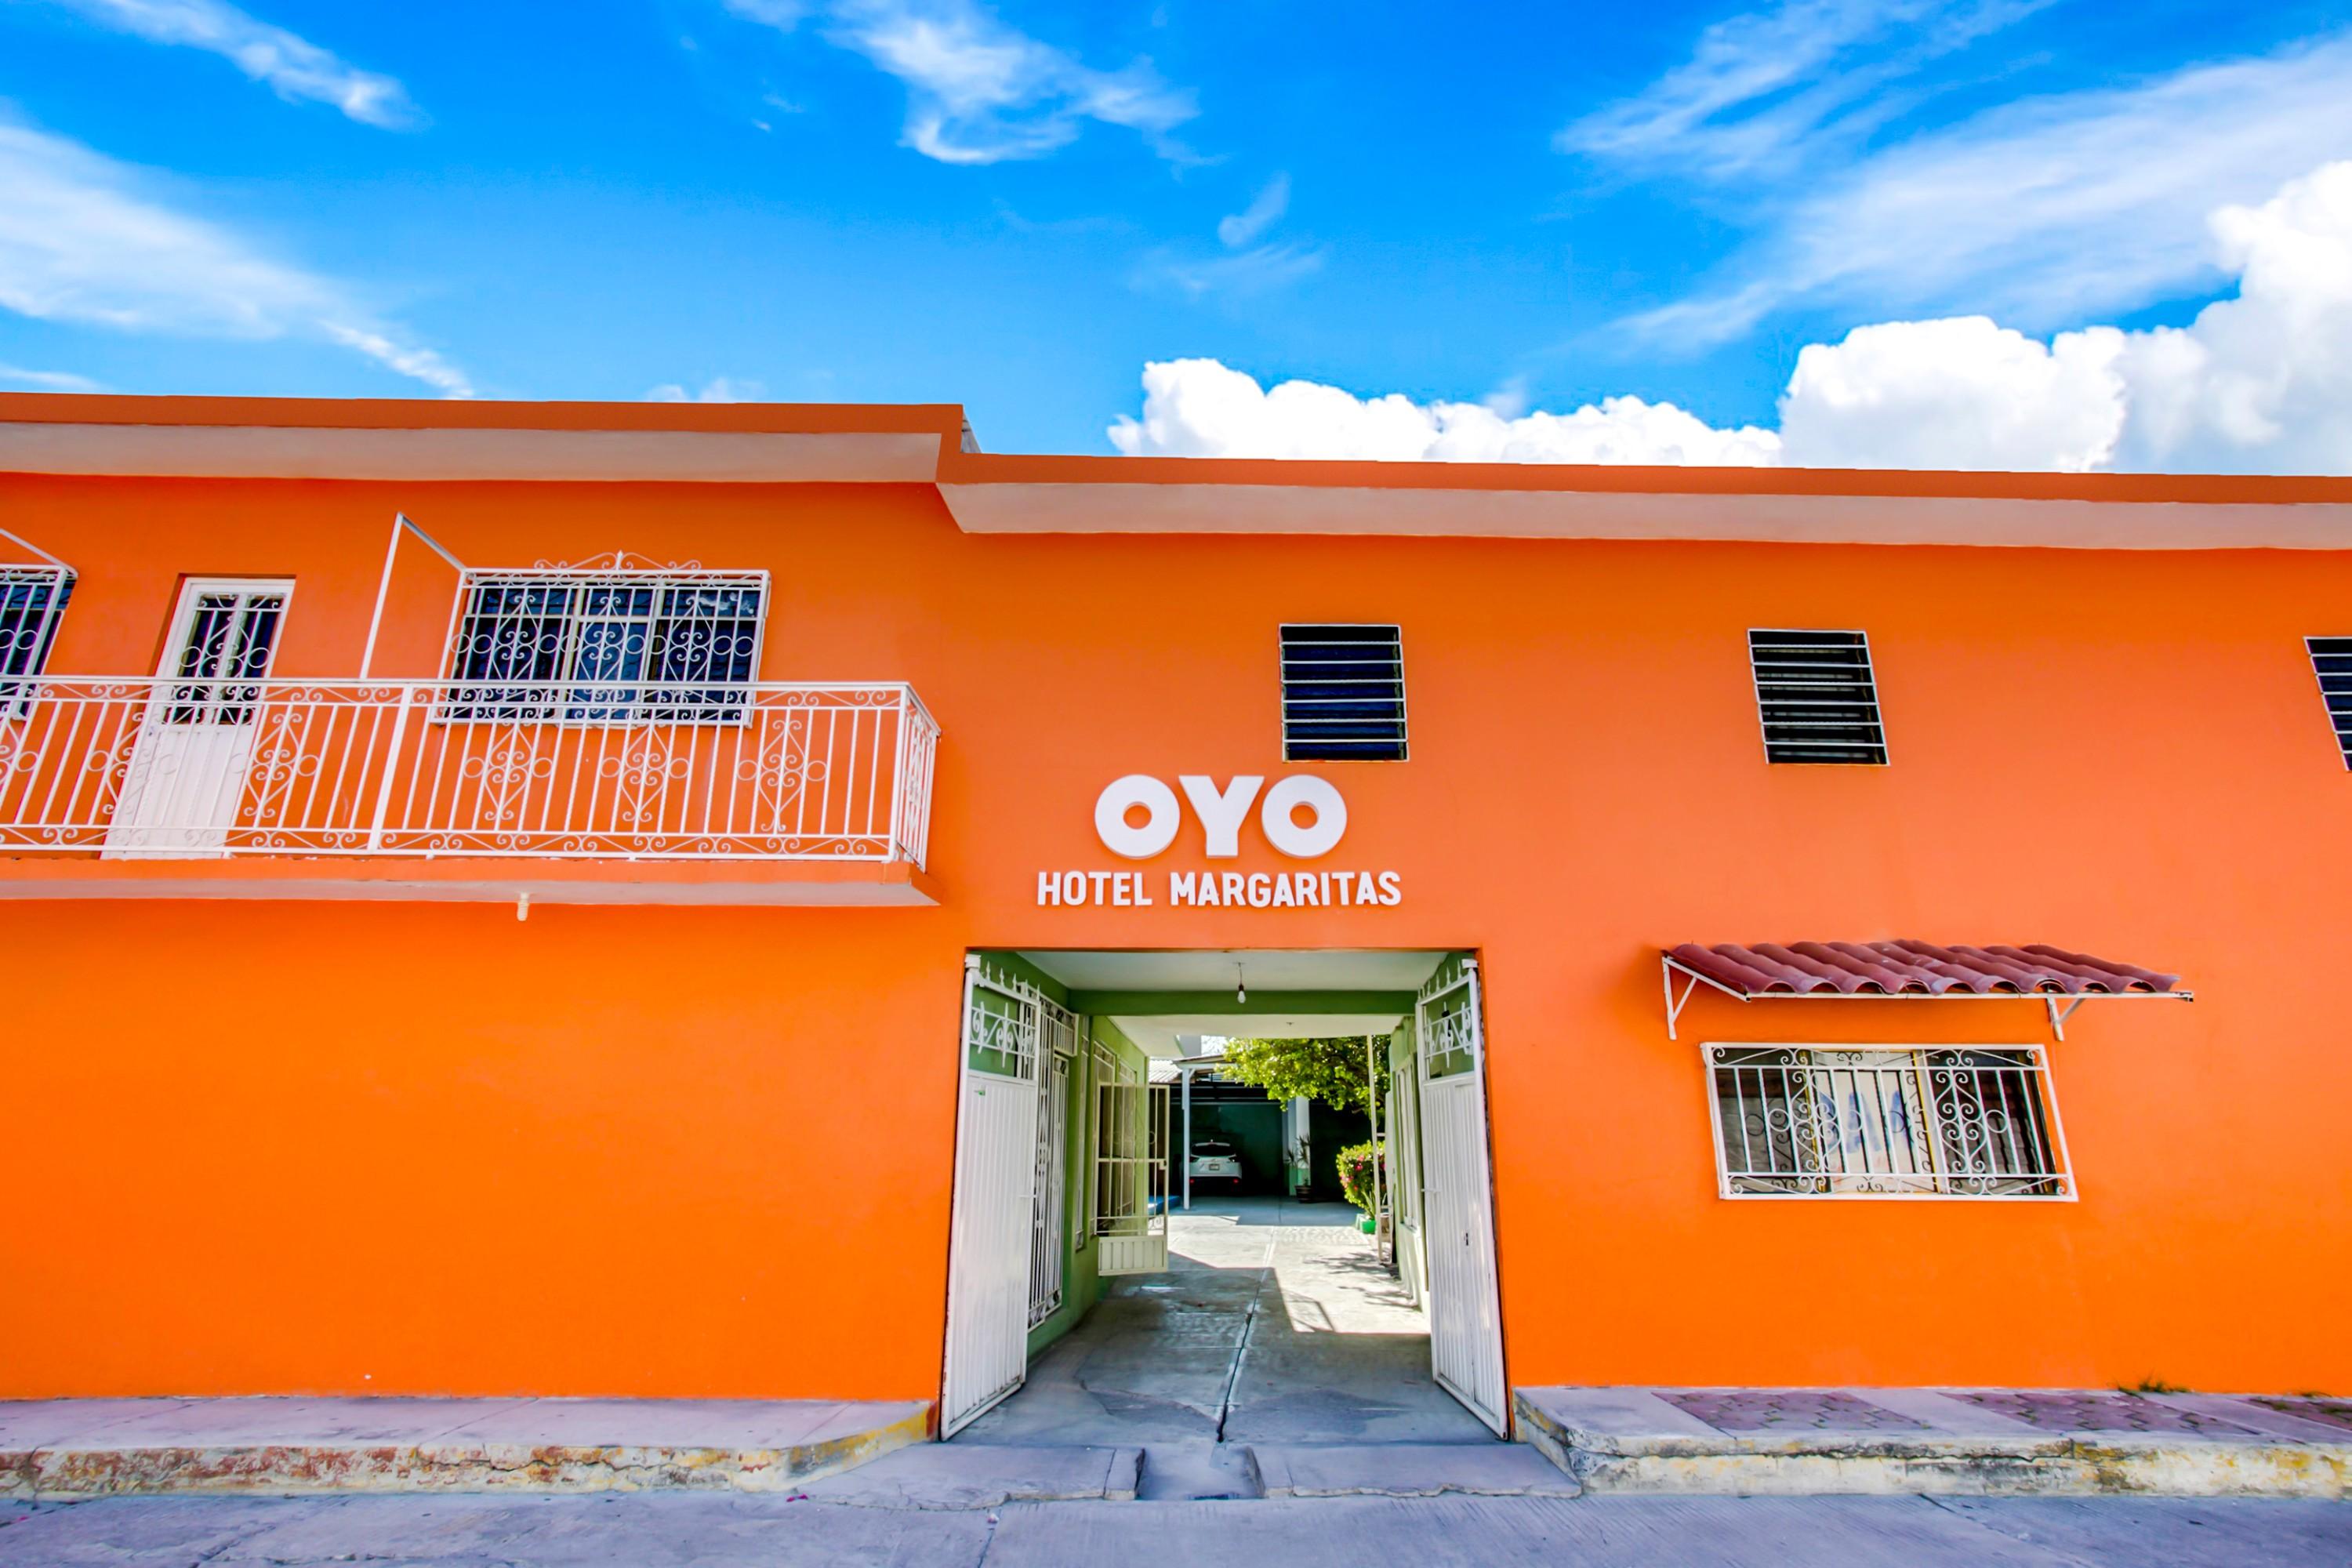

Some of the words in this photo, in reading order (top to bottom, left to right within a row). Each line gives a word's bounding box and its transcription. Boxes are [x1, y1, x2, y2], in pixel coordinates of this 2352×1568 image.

[1094, 774, 1348, 859] OYO
[1037, 871, 1152, 906] HOTEL
[1170, 871, 1402, 908] MARGARITAS
